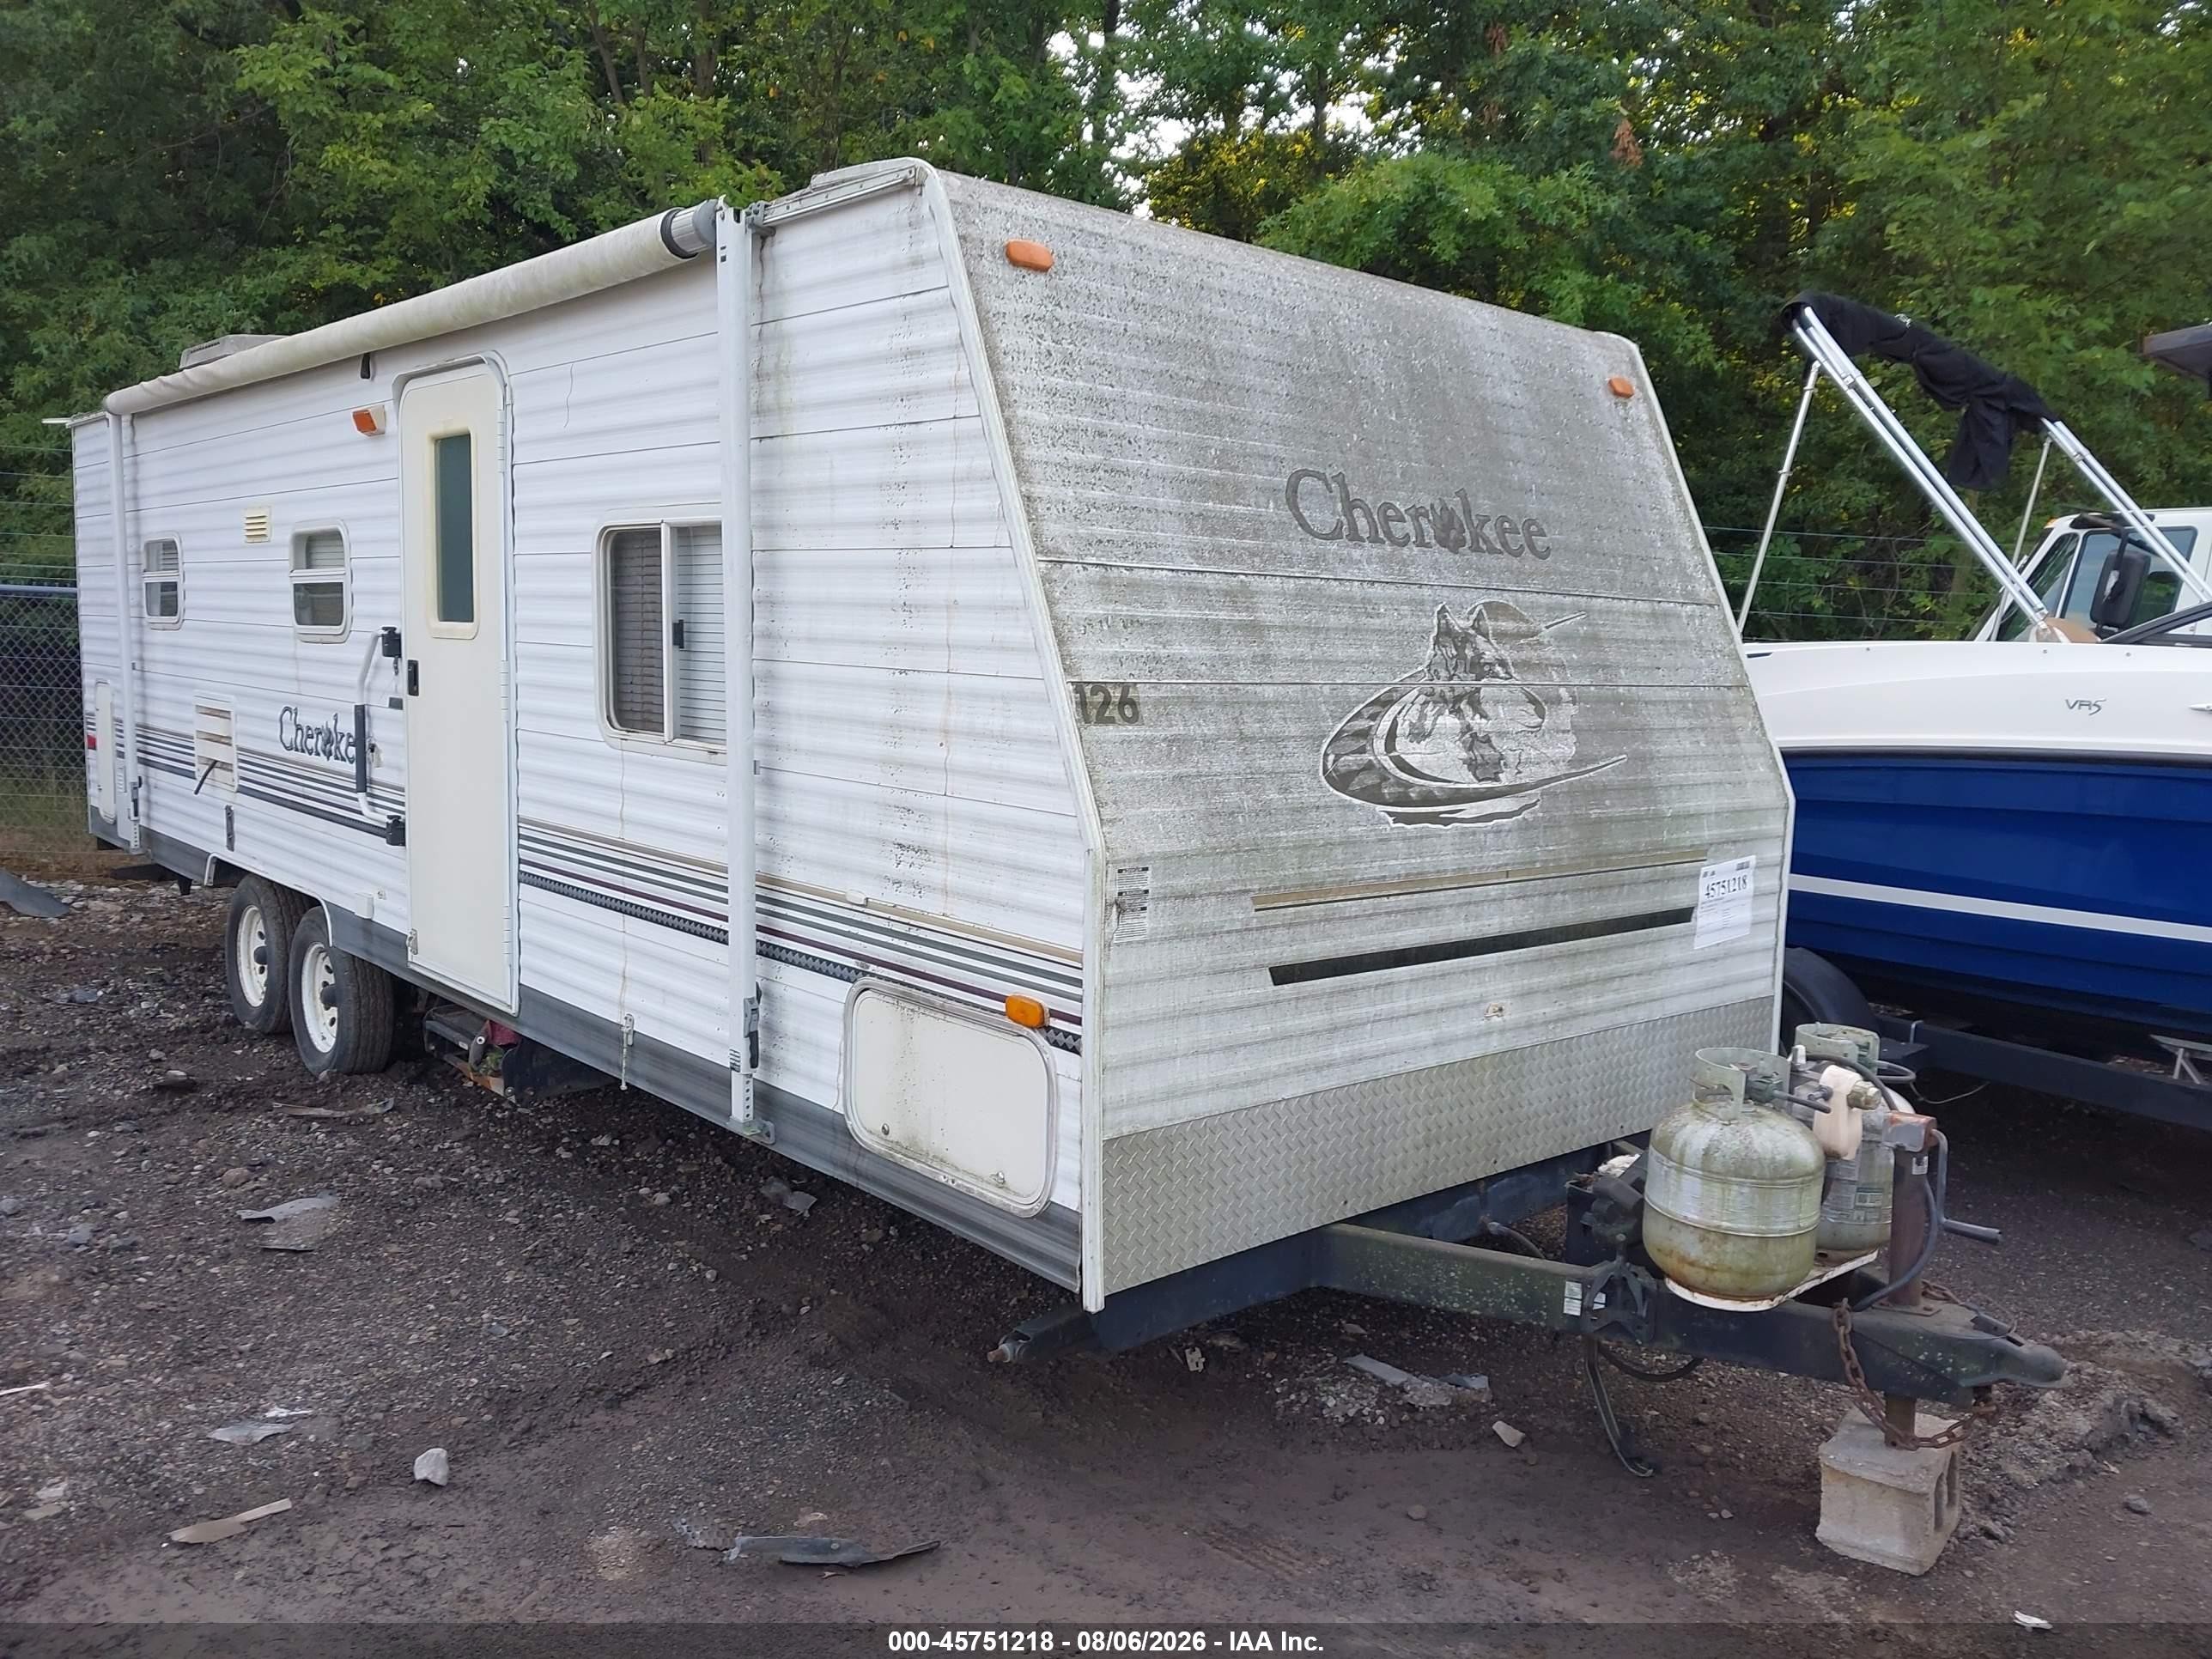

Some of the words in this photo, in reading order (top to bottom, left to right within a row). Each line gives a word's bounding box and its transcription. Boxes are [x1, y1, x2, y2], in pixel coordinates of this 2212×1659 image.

[1285, 469, 1551, 560] Cherokee
[1075, 684, 1139, 724] 126
[279, 706, 356, 764] Cheroke
[1705, 874, 1747, 899] 45751218
